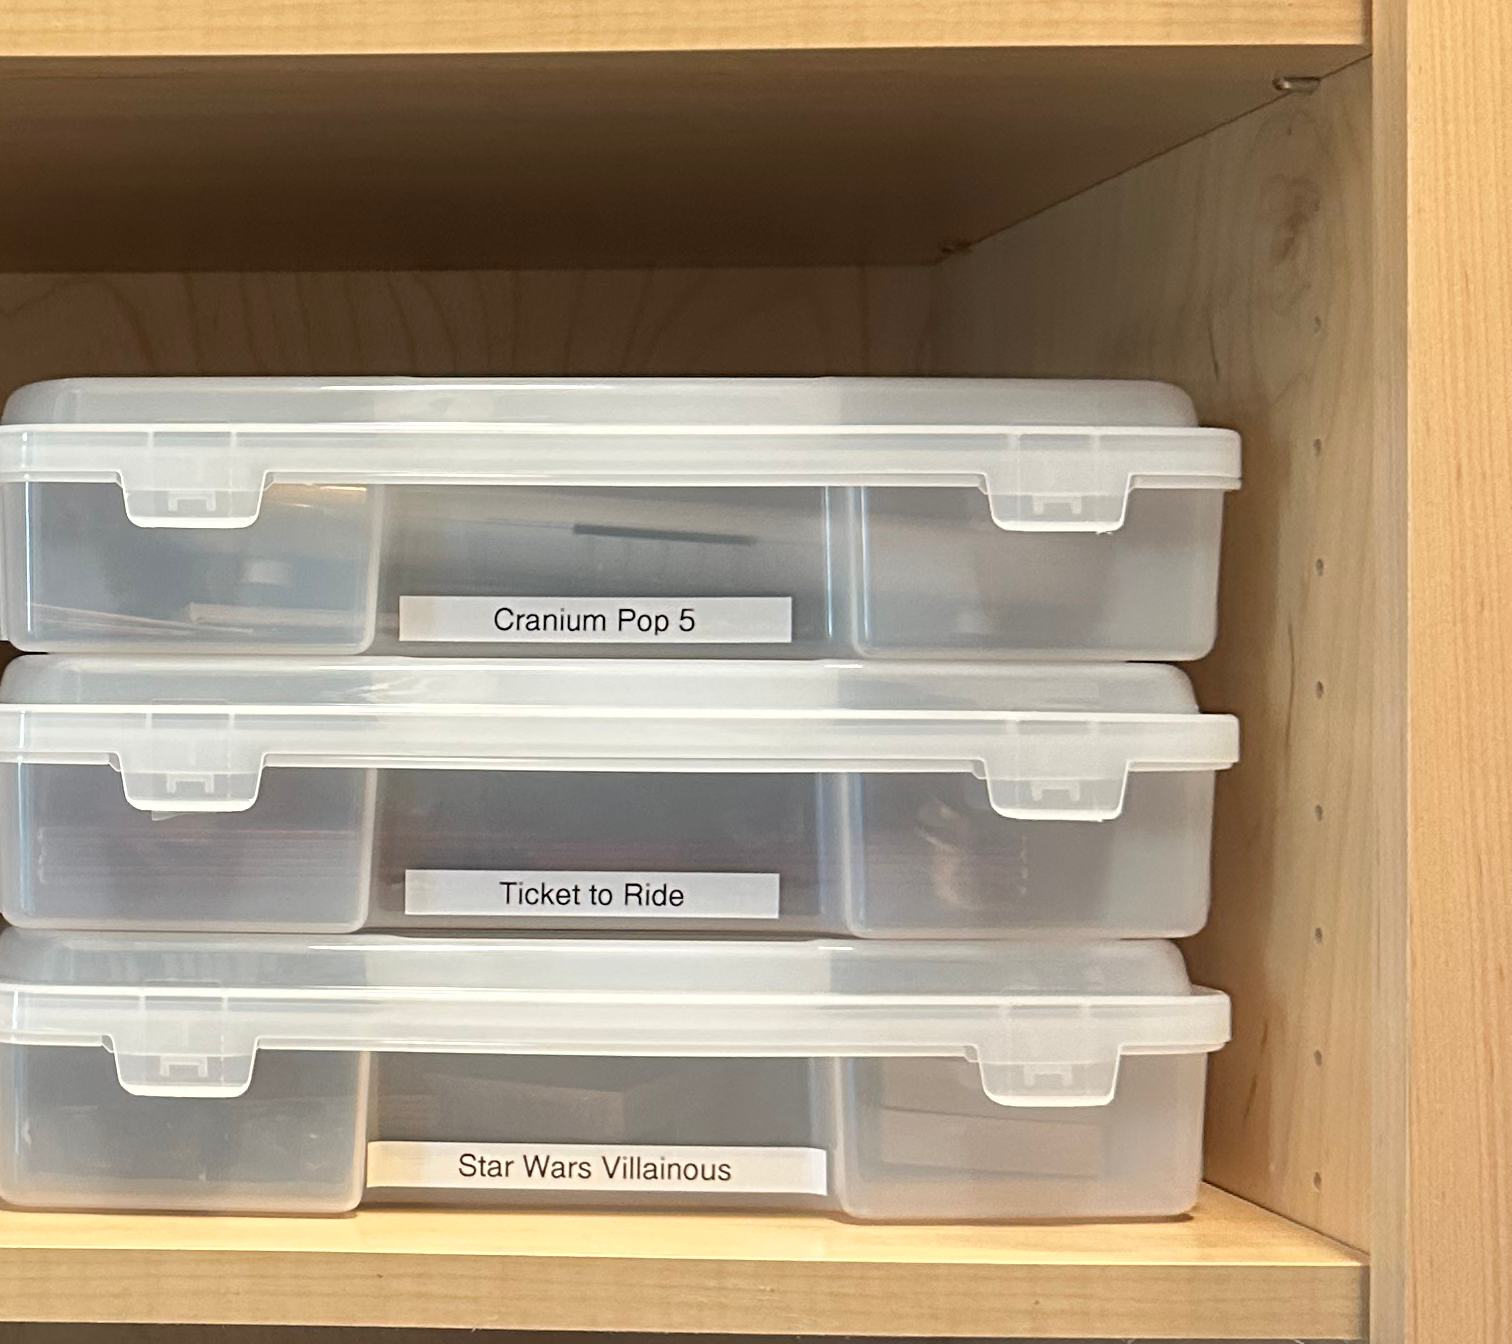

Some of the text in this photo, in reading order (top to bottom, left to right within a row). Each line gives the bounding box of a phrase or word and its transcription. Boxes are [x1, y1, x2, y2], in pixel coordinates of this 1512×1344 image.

[493, 606, 696, 637] Cranium Pop 5
[499, 880, 685, 908] Ticket to Ride
[458, 1153, 732, 1182] Star Wars Villainous
